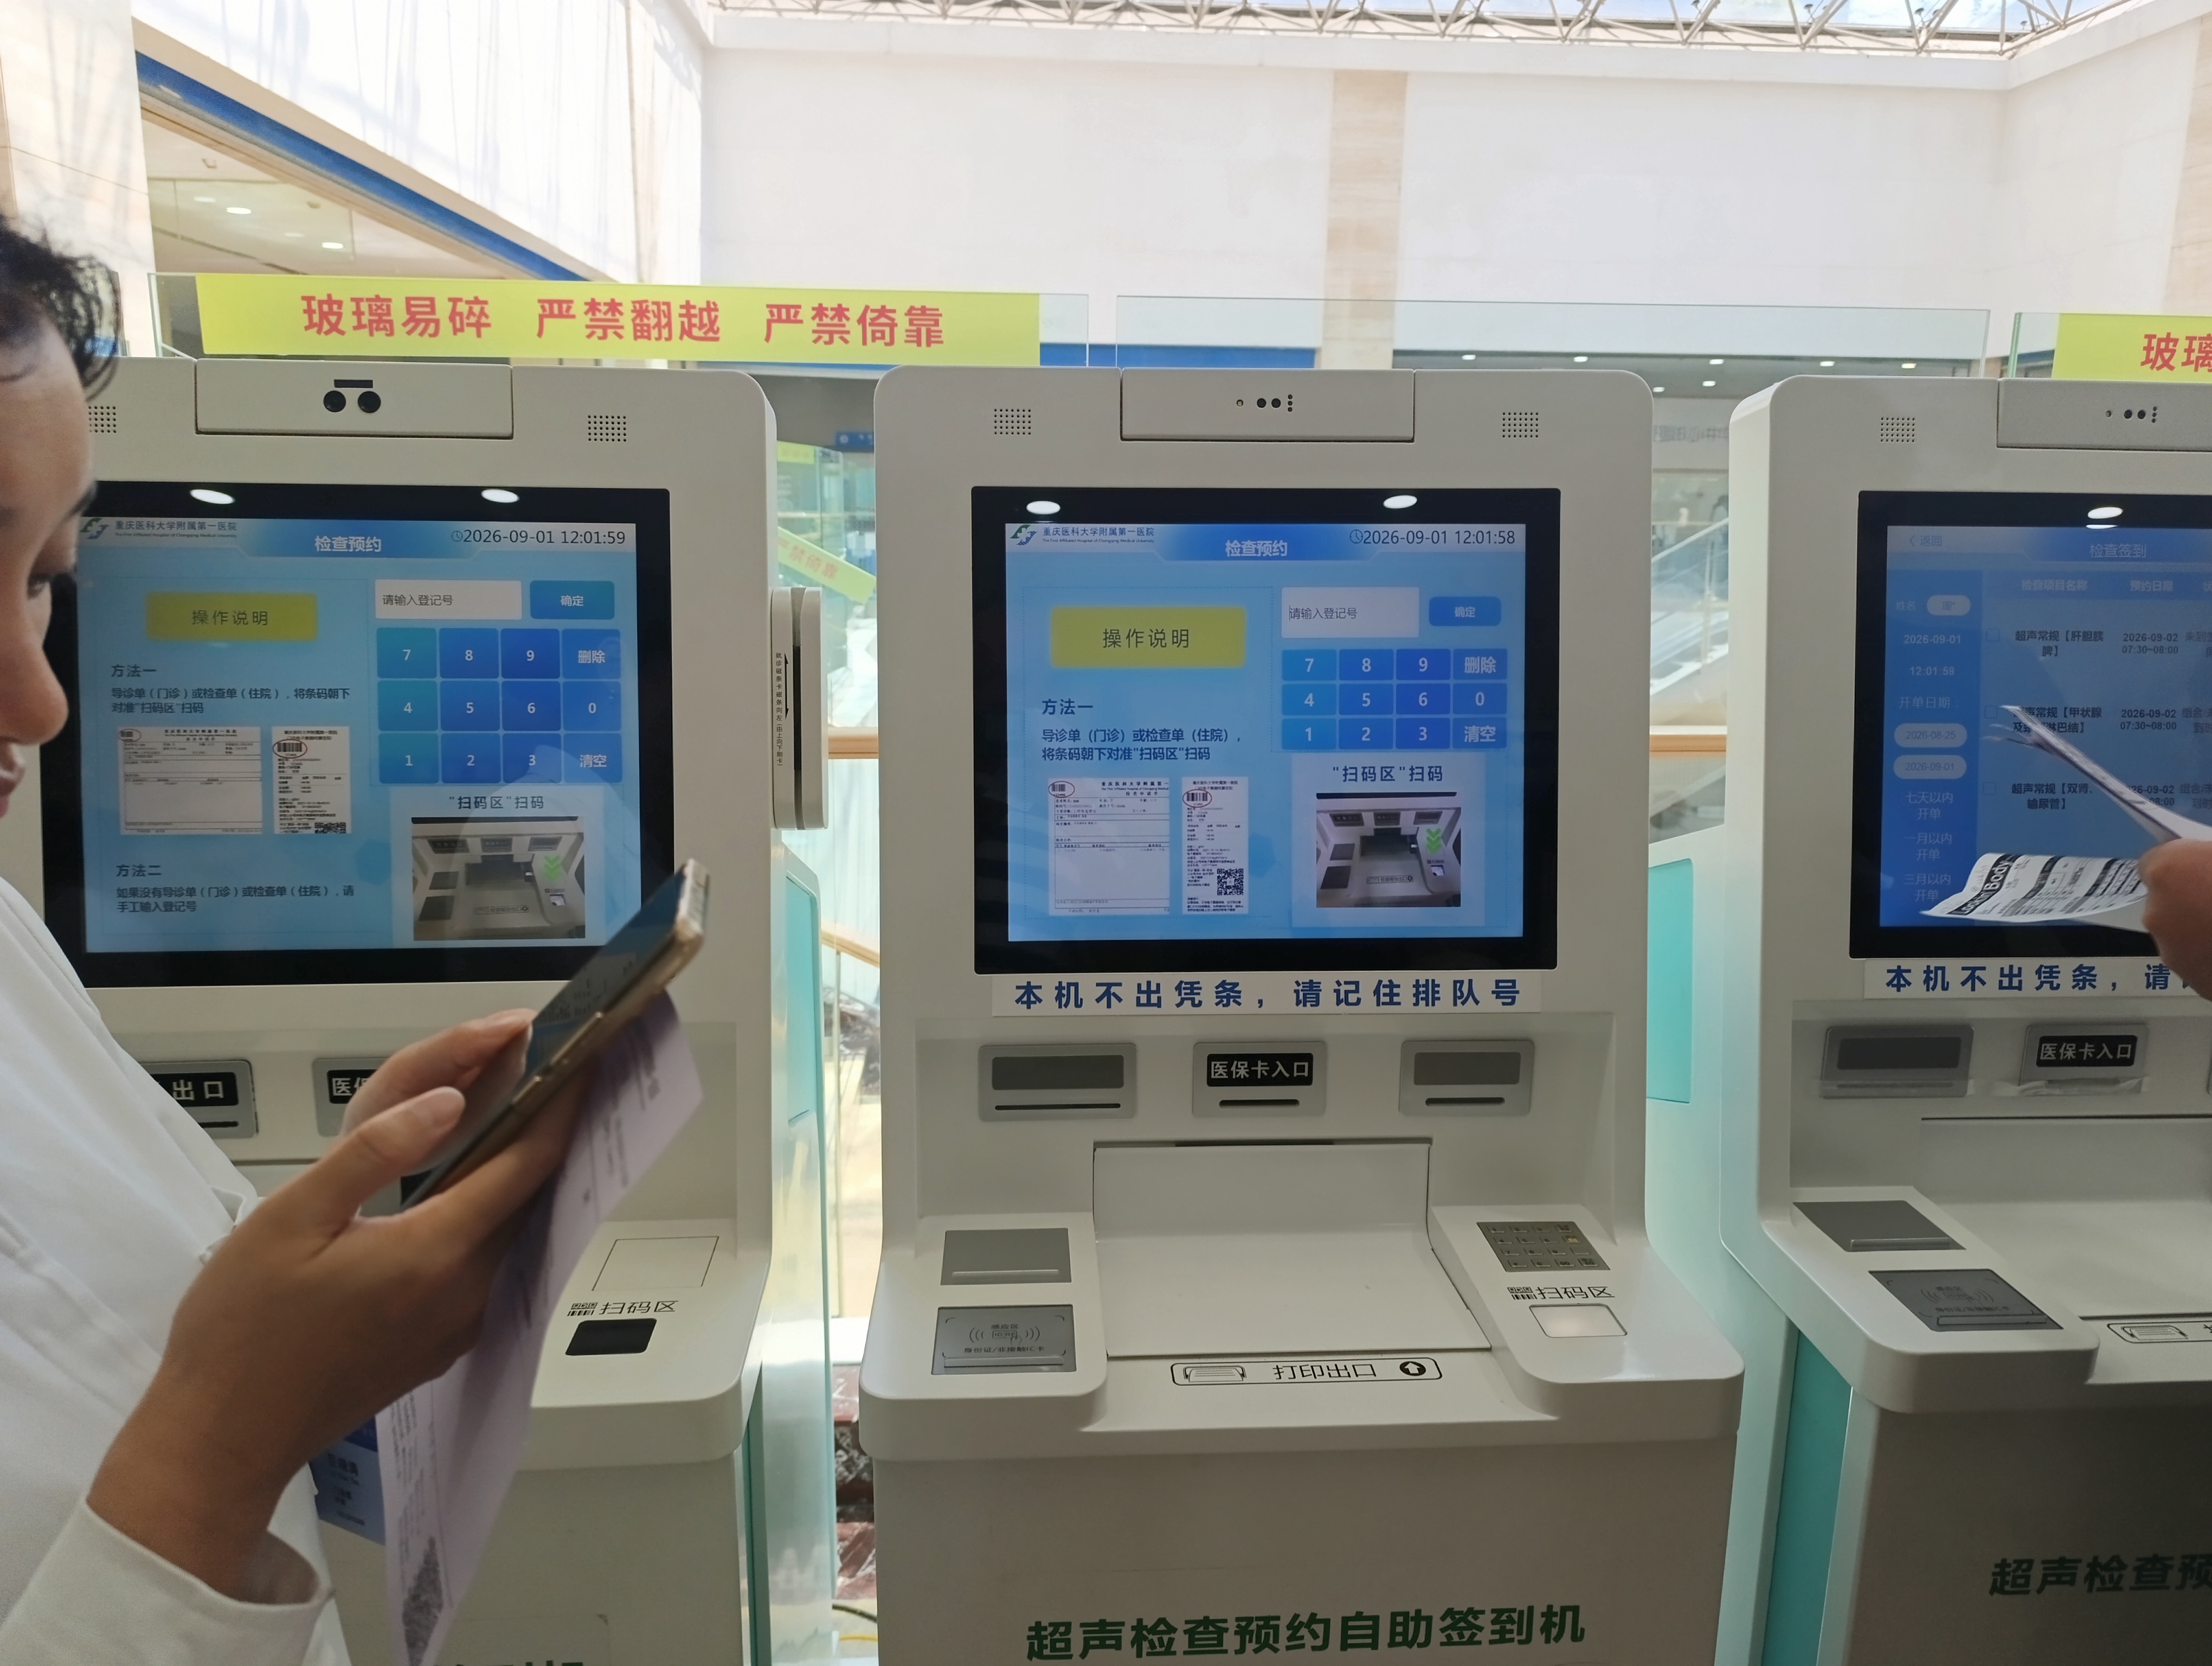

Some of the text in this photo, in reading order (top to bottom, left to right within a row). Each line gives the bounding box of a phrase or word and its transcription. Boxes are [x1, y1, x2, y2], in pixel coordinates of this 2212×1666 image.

[301, 296, 946, 347] 玻璃易碎 严禁翻越 严禁倚靠
[115, 520, 237, 531] 重庆医科大学附属第一医院
[1043, 527, 1154, 536] 重庆医科大学附属第一医院
[463, 529, 625, 544] 2026-09-01 12:01:59
[1363, 530, 1515, 544] 2026-09-01 12:01:58
[1920, 535, 1942, 547] 返回
[314, 535, 382, 553] 检查预约
[1225, 540, 1288, 557] 检查预约
[2090, 544, 2147, 559] 检查签到
[2022, 580, 2088, 592] 检查项目名称
[2130, 580, 2173, 592] 预约日期
[382, 594, 453, 606] 请输入登记号
[561, 595, 584, 607] 确定
[1896, 601, 1915, 611] 姓名
[192, 610, 268, 626] 操作说明
[1290, 607, 1358, 620] 请输入登记号
[1455, 606, 1476, 617] 确定
[1103, 629, 1189, 648] 操作说明
[1904, 635, 1962, 644] 2026-09-01
[2015, 631, 2104, 642] 超声常规【肝胆胰
[2124, 633, 2178, 643] 2026-09-02
[403, 650, 411, 661] 7
[465, 650, 473, 661] 8
[526, 650, 535, 662] 9
[2042, 646, 2059, 657] 脾】
[2123, 645, 2178, 654] 07:30~08:00
[578, 650, 606, 664] 删除
[111, 664, 157, 678] 方法一
[1304, 658, 1314, 672] 7
[1362, 658, 1372, 672] 8
[1418, 658, 1429, 672] 9
[1464, 656, 1496, 674] 删除
[1910, 667, 1954, 676] 12:01:59
[1304, 692, 1315, 706] 4
[1362, 693, 1371, 706] 5
[1418, 692, 1428, 707] 6
[1475, 691, 1485, 706] 0
[404, 703, 413, 714] 4
[466, 703, 474, 714] 5
[528, 702, 536, 714] 6
[588, 702, 596, 713] 0
[1041, 698, 1094, 716] 方法一
[2014, 707, 2102, 718] 声常规【甲状腺
[2121, 709, 2176, 719] 2026-09-02
[2120, 722, 2177, 731] 07:30~08:00
[1306, 727, 1313, 741] 1
[1361, 727, 1371, 741] 2
[1418, 727, 1427, 741] 3
[1464, 726, 1496, 742] 清空
[406, 755, 413, 766] 1
[467, 755, 475, 766] 2
[528, 755, 536, 766] 3
[579, 754, 607, 768] 清空
[1905, 762, 1954, 771] 2026-09-01
[2128, 785, 2174, 794] 26-09-02
[1906, 792, 1953, 804] 七天以内
[2027, 798, 2066, 809] 输尿管】
[1917, 808, 1941, 820] 开单
[1905, 832, 1952, 845] 一月以内
[1916, 848, 1939, 861] 开单
[116, 864, 161, 877] 方法二
[1904, 873, 1951, 886] 三月以内
[1915, 889, 1938, 902] 开单
[117, 901, 197, 913] 手工输入登记号
[1886, 963, 2190, 992] 本机不出凭条，请
[1015, 979, 1520, 1010] 本机不出凭条，请记住排队号
[2040, 1043, 2132, 1060] 医保卡入口
[1210, 1060, 1309, 1078] 医保卡入口
[1536, 1287, 1615, 1299] 扫码区
[599, 1300, 678, 1315] 扫码区
[1272, 1362, 1378, 1380] 打印出口
[1026, 1605, 1586, 1661] 超声检查预约自助签到机
